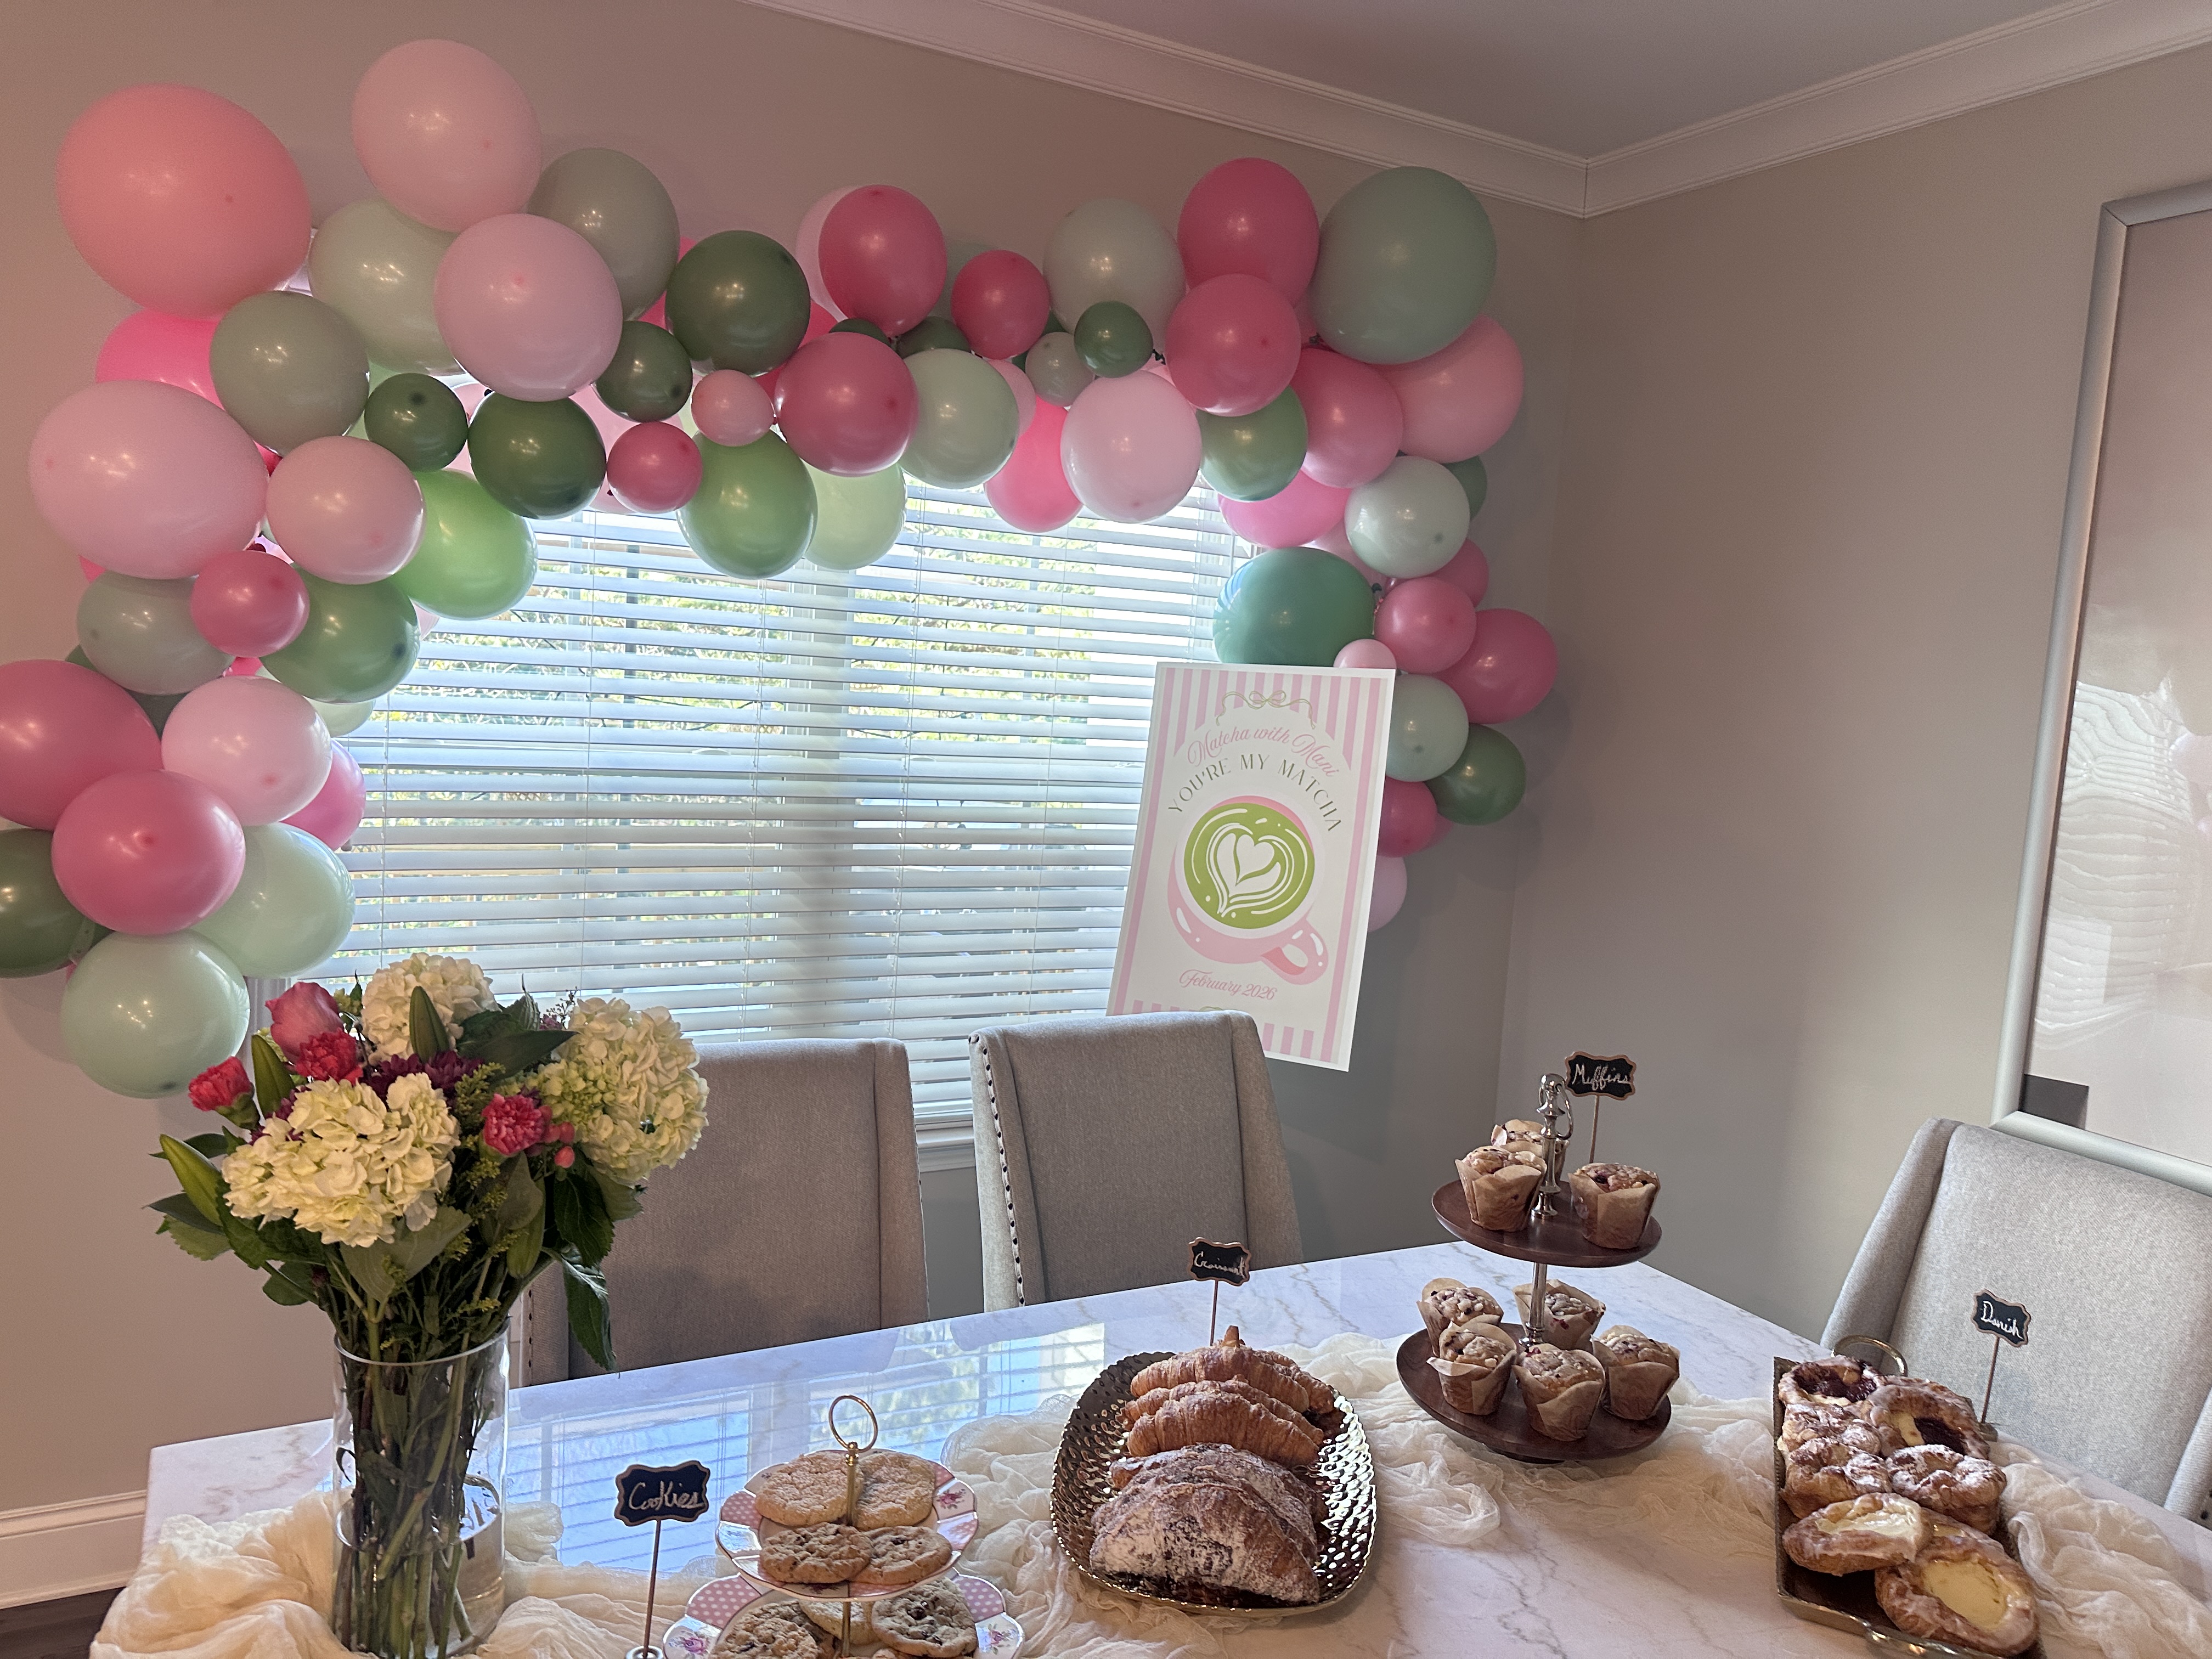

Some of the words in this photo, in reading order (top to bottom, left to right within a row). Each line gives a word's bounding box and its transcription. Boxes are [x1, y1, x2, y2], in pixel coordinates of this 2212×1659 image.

[1187, 726, 1250, 767] Matcha
[1253, 727, 1290, 744] with
[1291, 733, 1339, 777] Mani
[1167, 758, 1231, 814] YOU'RE
[1240, 753, 1270, 770] MY
[1277, 759, 1342, 832] MATCHA
[1179, 969, 1242, 996] February
[1241, 983, 1278, 1000] 2026
[1571, 1063, 1631, 1091] Muffins
[1980, 1300, 2024, 1340] Danish
